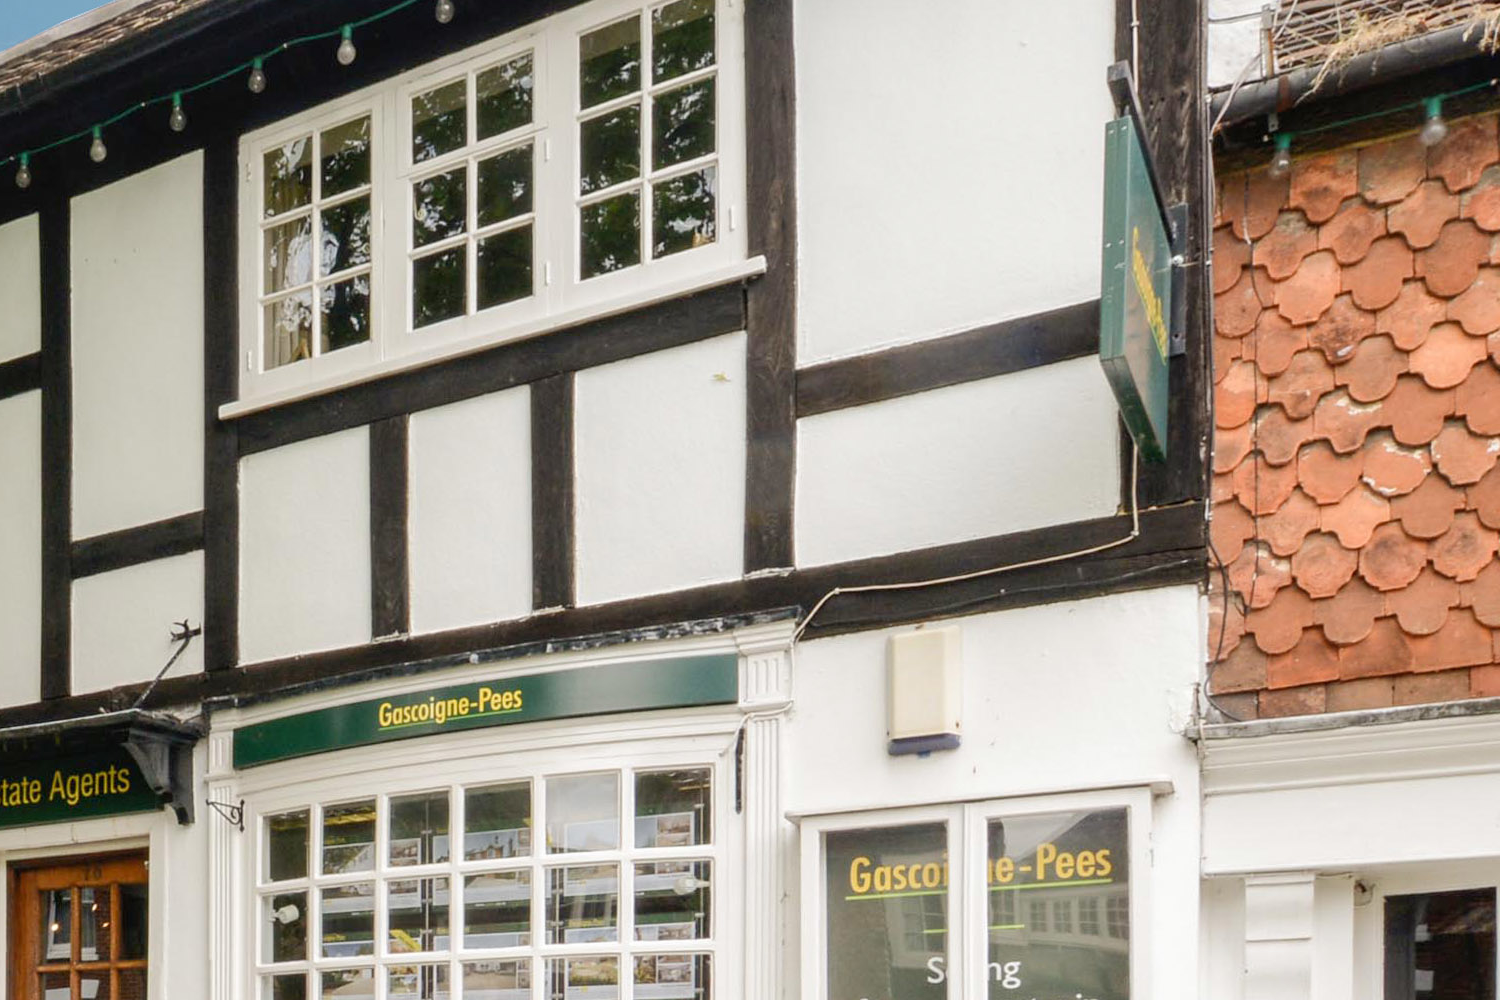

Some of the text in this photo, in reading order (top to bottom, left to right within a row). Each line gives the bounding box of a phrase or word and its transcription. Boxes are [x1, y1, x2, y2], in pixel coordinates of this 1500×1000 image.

[379, 687, 522, 727] Gascoigne-Pees
[50, 764, 131, 806] Agents
[849, 843, 1113, 893] Gascoie-Pees
